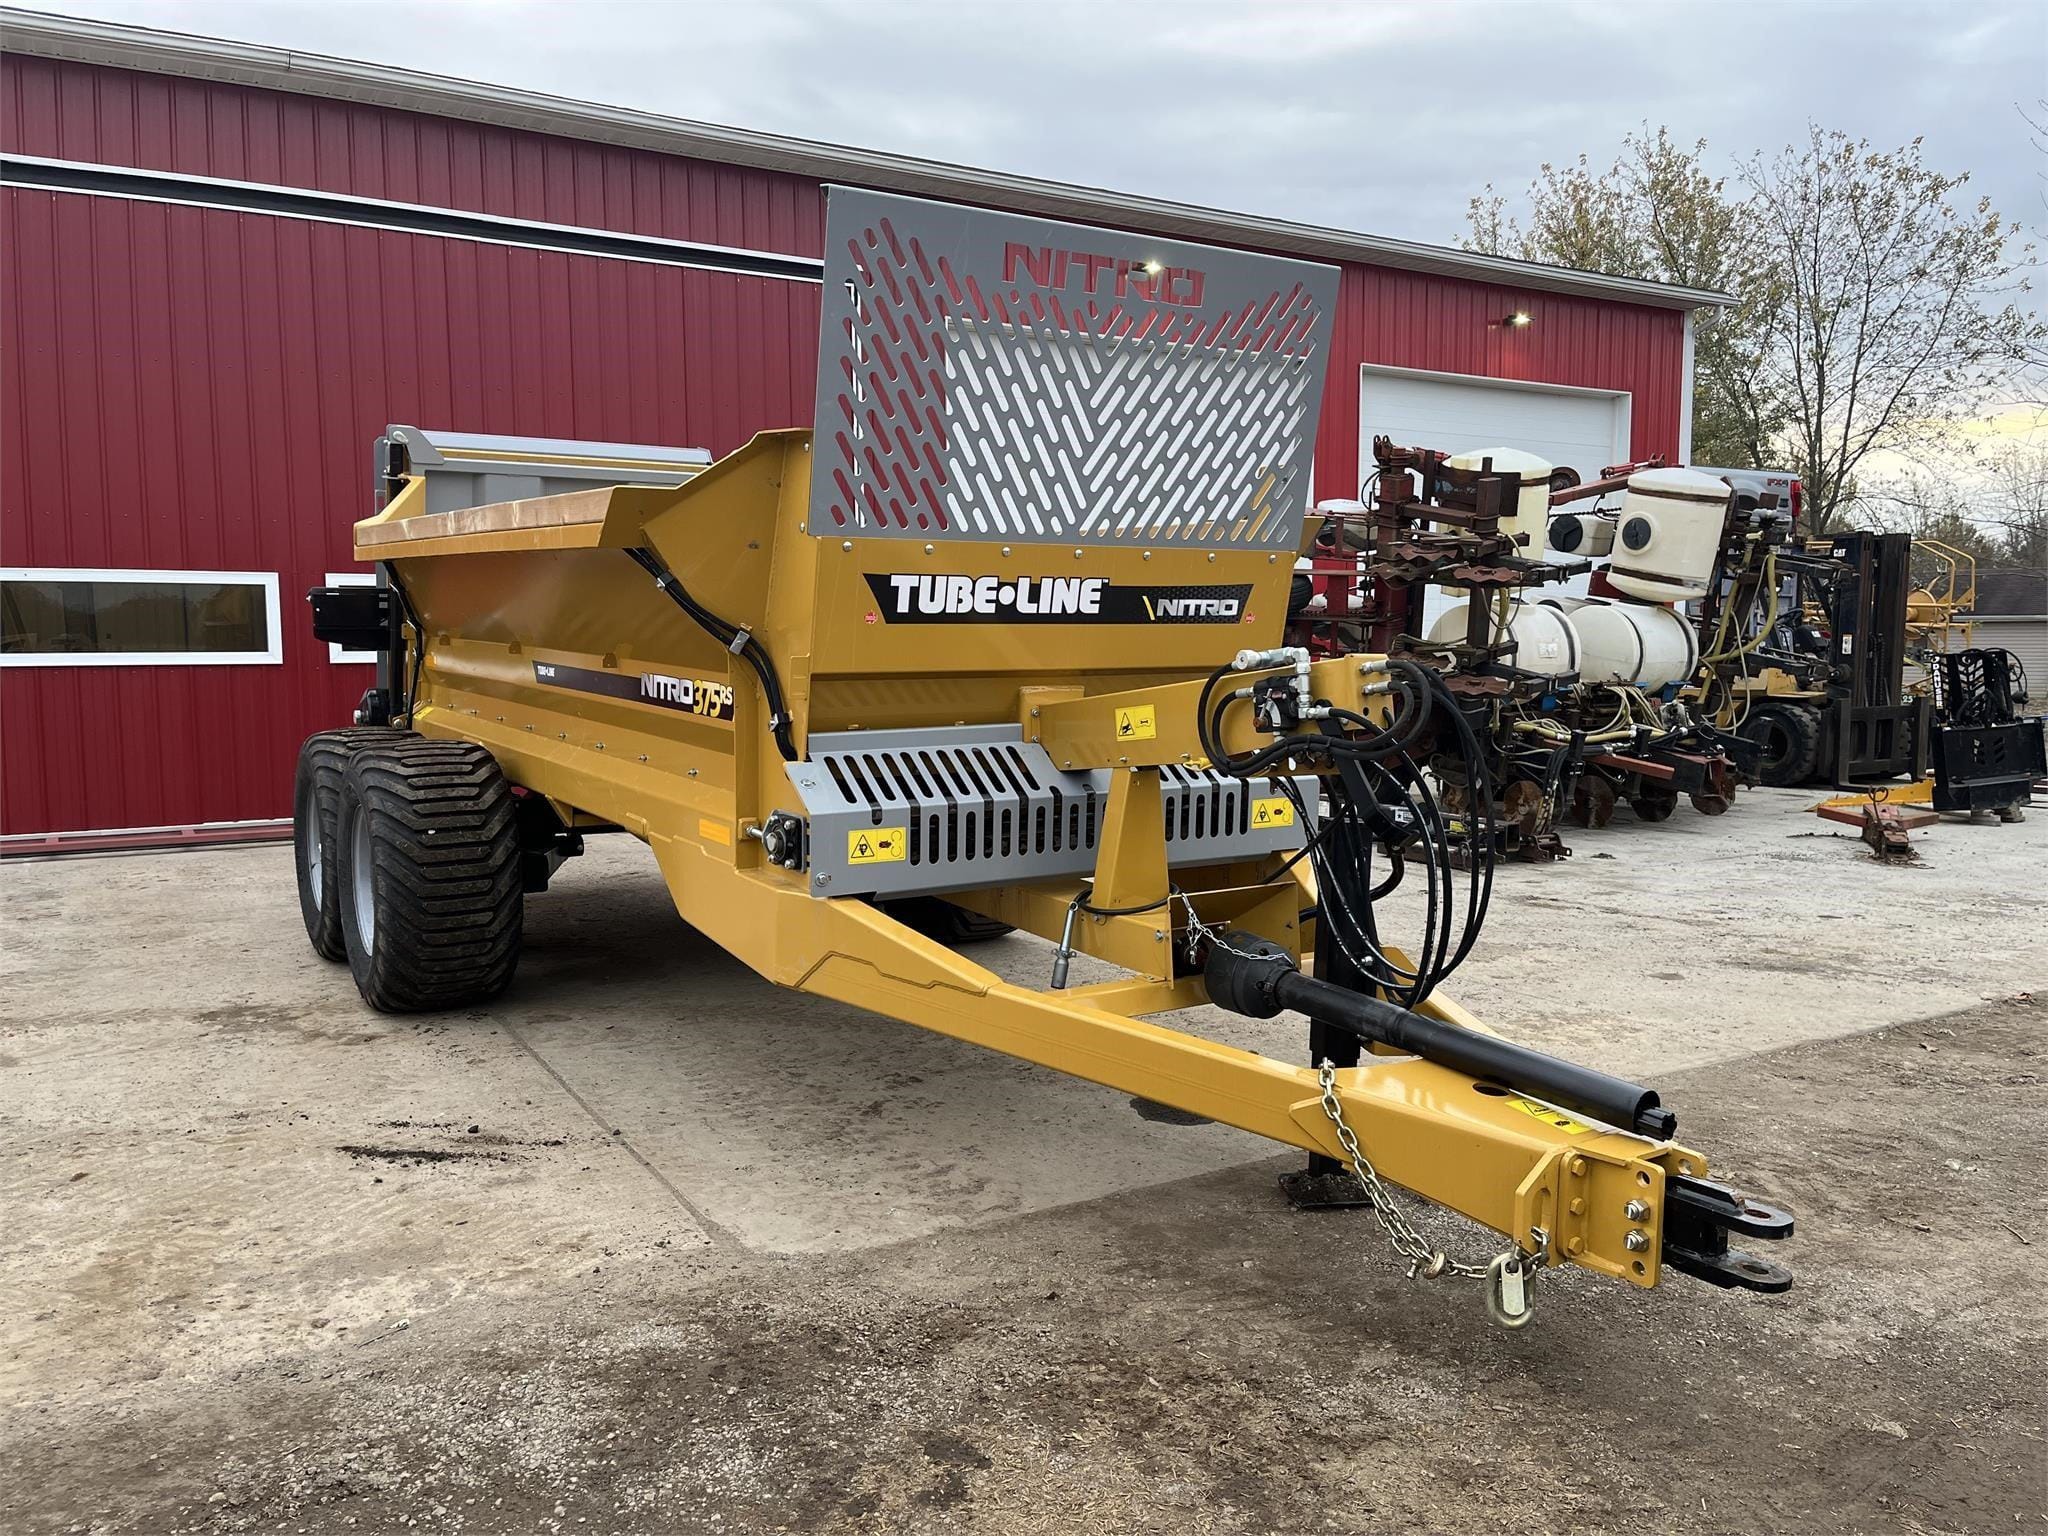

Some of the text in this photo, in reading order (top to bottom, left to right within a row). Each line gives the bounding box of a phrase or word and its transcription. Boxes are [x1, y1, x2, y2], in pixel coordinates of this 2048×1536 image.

[1002, 242, 1206, 307] NITRO
[1767, 479, 1788, 487] FX4
[1833, 548, 1846, 557] CAT
[1156, 598, 1240, 617] NITRO
[1932, 663, 1944, 708] DANUSER
